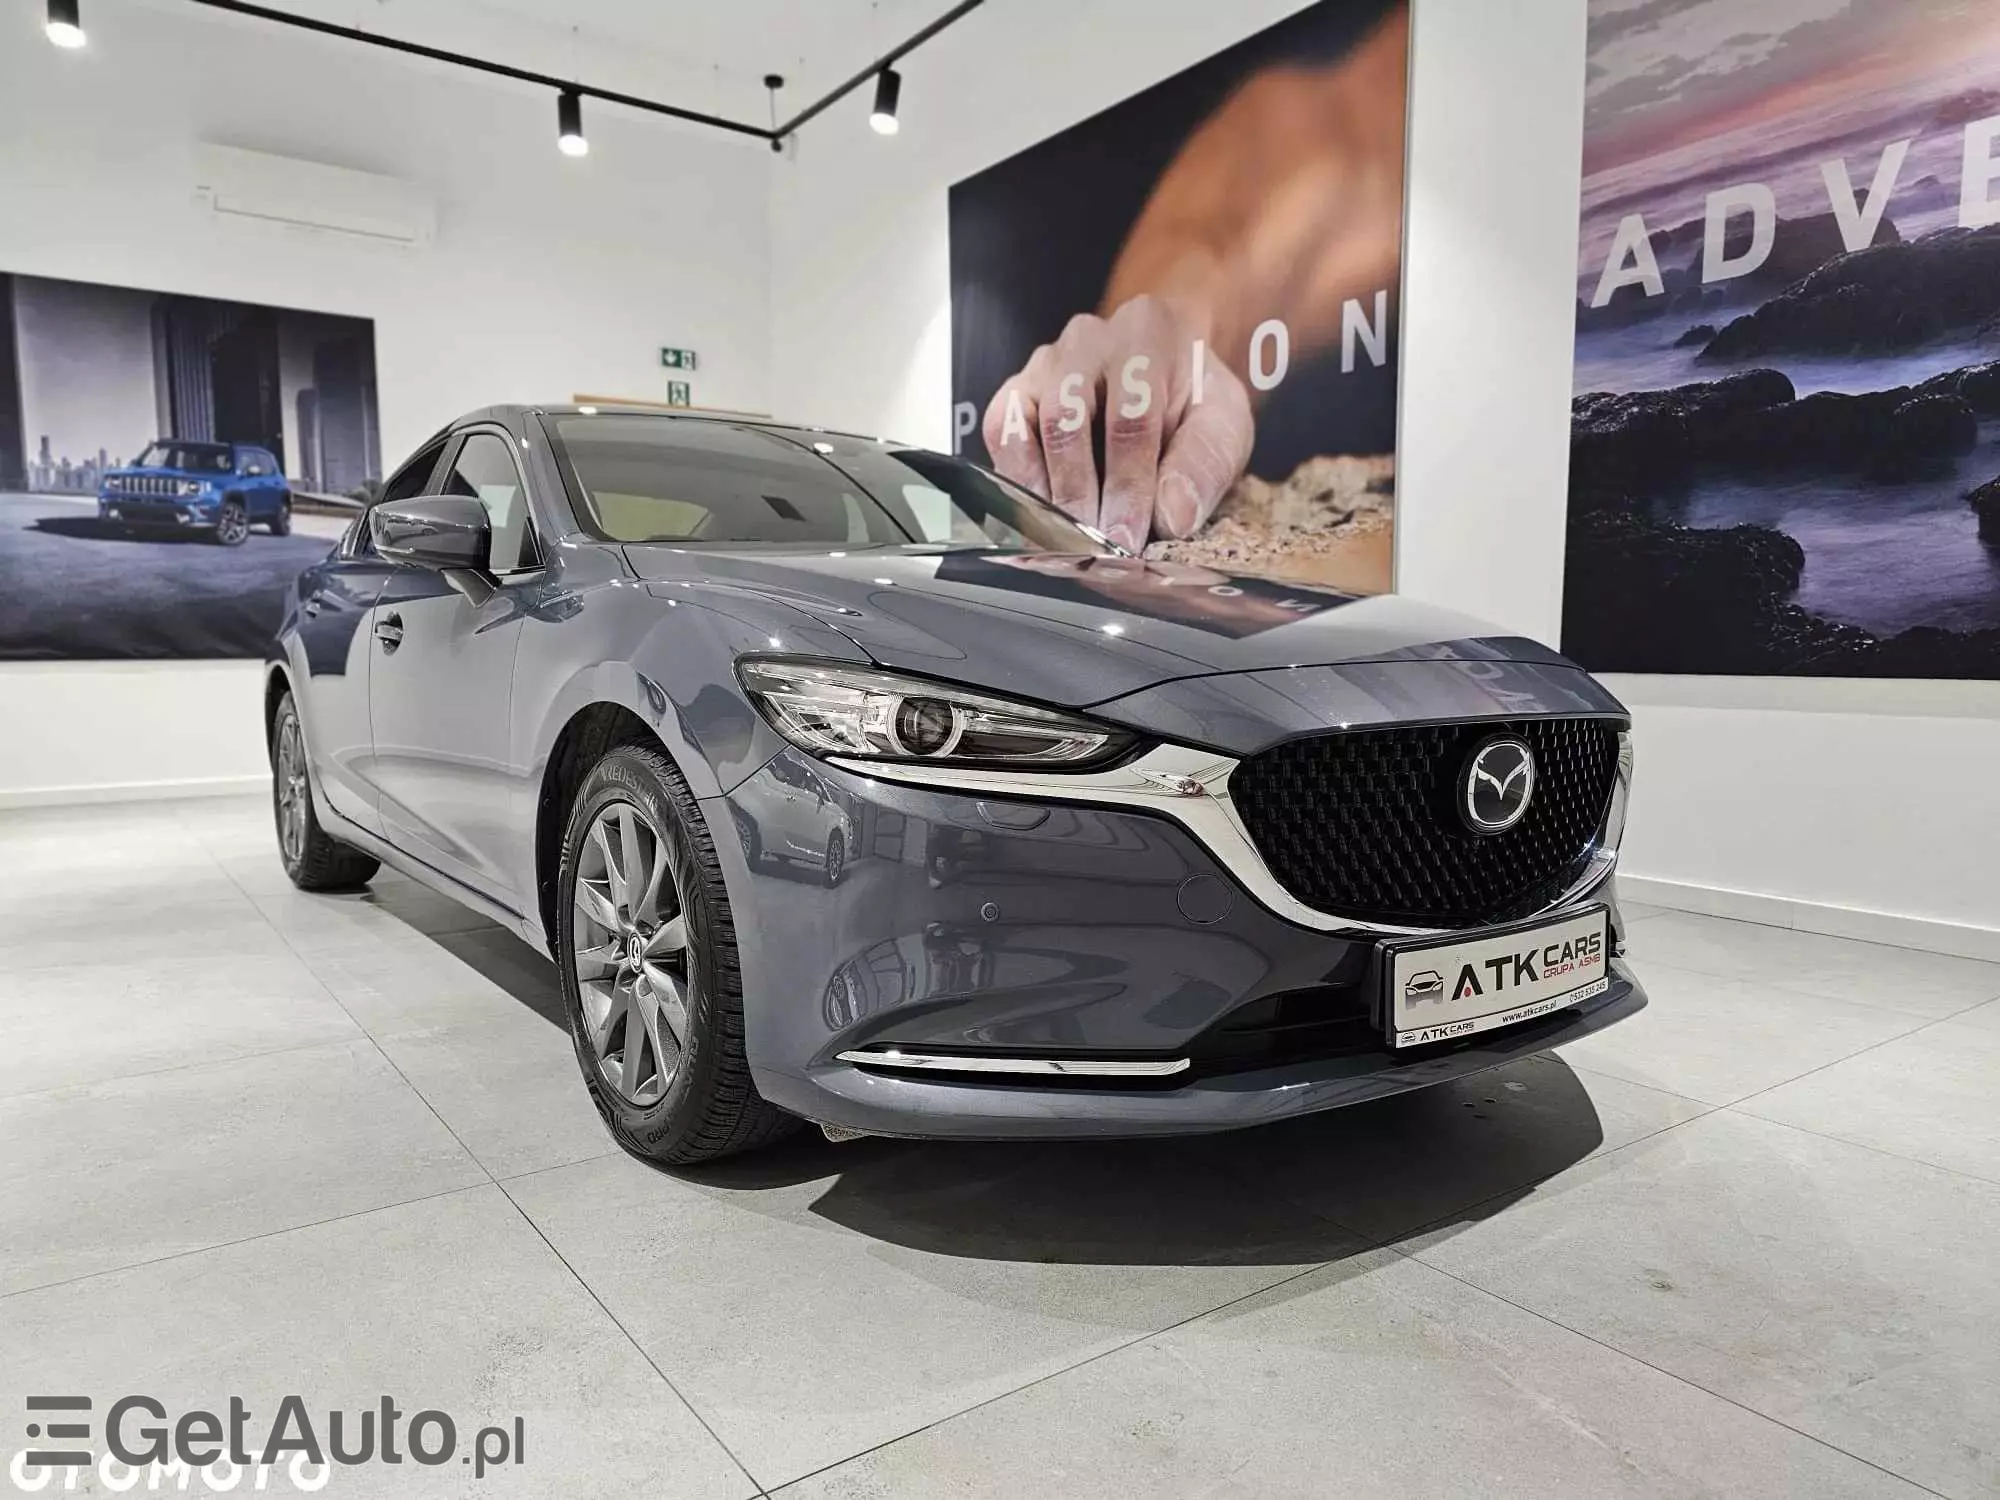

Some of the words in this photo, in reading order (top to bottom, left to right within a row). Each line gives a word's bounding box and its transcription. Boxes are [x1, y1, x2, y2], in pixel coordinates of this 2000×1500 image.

[1590, 114, 2000, 309] ADVE
[953, 289, 1388, 455] PASSION
[1452, 948, 1540, 1001] ATK
[1543, 931, 1601, 968] CARS
[1543, 962, 1575, 979] GRUPA
[1420, 1027, 1449, 1041] ATK
[1502, 1000, 1557, 1023] www.atkcars.pl
